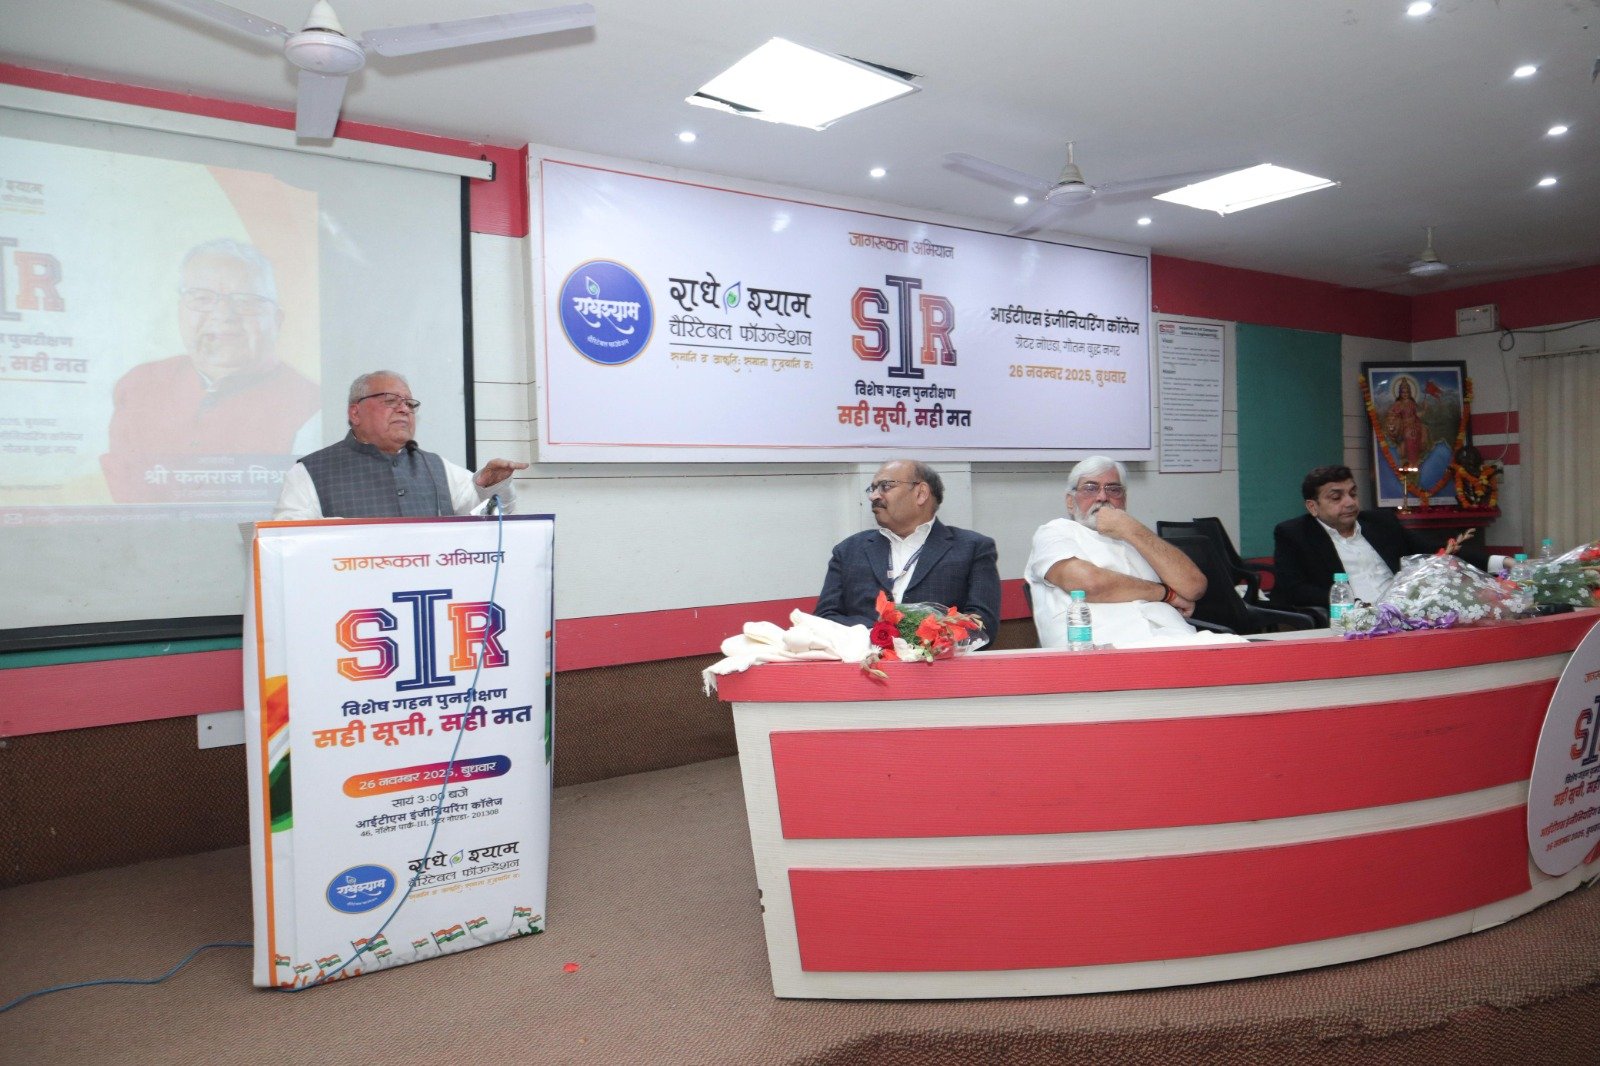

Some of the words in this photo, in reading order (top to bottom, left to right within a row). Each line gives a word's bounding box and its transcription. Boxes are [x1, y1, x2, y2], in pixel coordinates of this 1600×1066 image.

[848, 232, 909, 253] जागरूकता
[911, 238, 955, 259] अभियान
[668, 271, 721, 312] राधे
[746, 287, 812, 318] श्याम
[669, 314, 733, 340] चैरिटेबल
[850, 274, 957, 379] SIR
[990, 305, 1042, 326] आईटीएस
[1044, 309, 1105, 332] इंजीनियरिंग
[1107, 316, 1140, 335] कॉलेज
[10, 352, 49, 373] सही
[53, 358, 89, 373] मत
[1103, 344, 1120, 356] नगर
[1009, 365, 1023, 377] 26
[1025, 365, 1063, 380] नवम्बर
[1065, 369, 1094, 384] 2025,
[1096, 369, 1127, 387] बुधवार
[855, 379, 884, 396] विशेष
[886, 385, 911, 398] गहन
[912, 383, 956, 403] पुनरीक्षण
[837, 400, 870, 427] सही
[872, 401, 911, 432] सूची,
[914, 403, 944, 428] सही
[946, 410, 972, 426] मत
[144, 464, 169, 485] श्री
[173, 469, 242, 485] कलराज
[332, 554, 430, 571] जागरूकता
[436, 549, 505, 567] अभियान
[336, 589, 509, 692] SIR
[341, 699, 389, 717] विशेष
[393, 695, 432, 710] गहन
[436, 688, 507, 710] पुनरीक्षण
[313, 719, 366, 748] सही
[371, 712, 434, 747] सूची,
[439, 705, 487, 732] सही
[492, 705, 532, 725] मत
[359, 780, 376, 791] 26
[378, 772, 421, 787] नवम्बर
[461, 761, 497, 777] बुधवार
[417, 792, 445, 804] 3:00
[448, 788, 469, 799] बजे
[355, 813, 406, 829] आईटीएस
[471, 797, 503, 808] कॉलेज
[472, 808, 499, 819] 201308
[408, 851, 448, 874] राधे
[468, 841, 520, 863] श्याम
